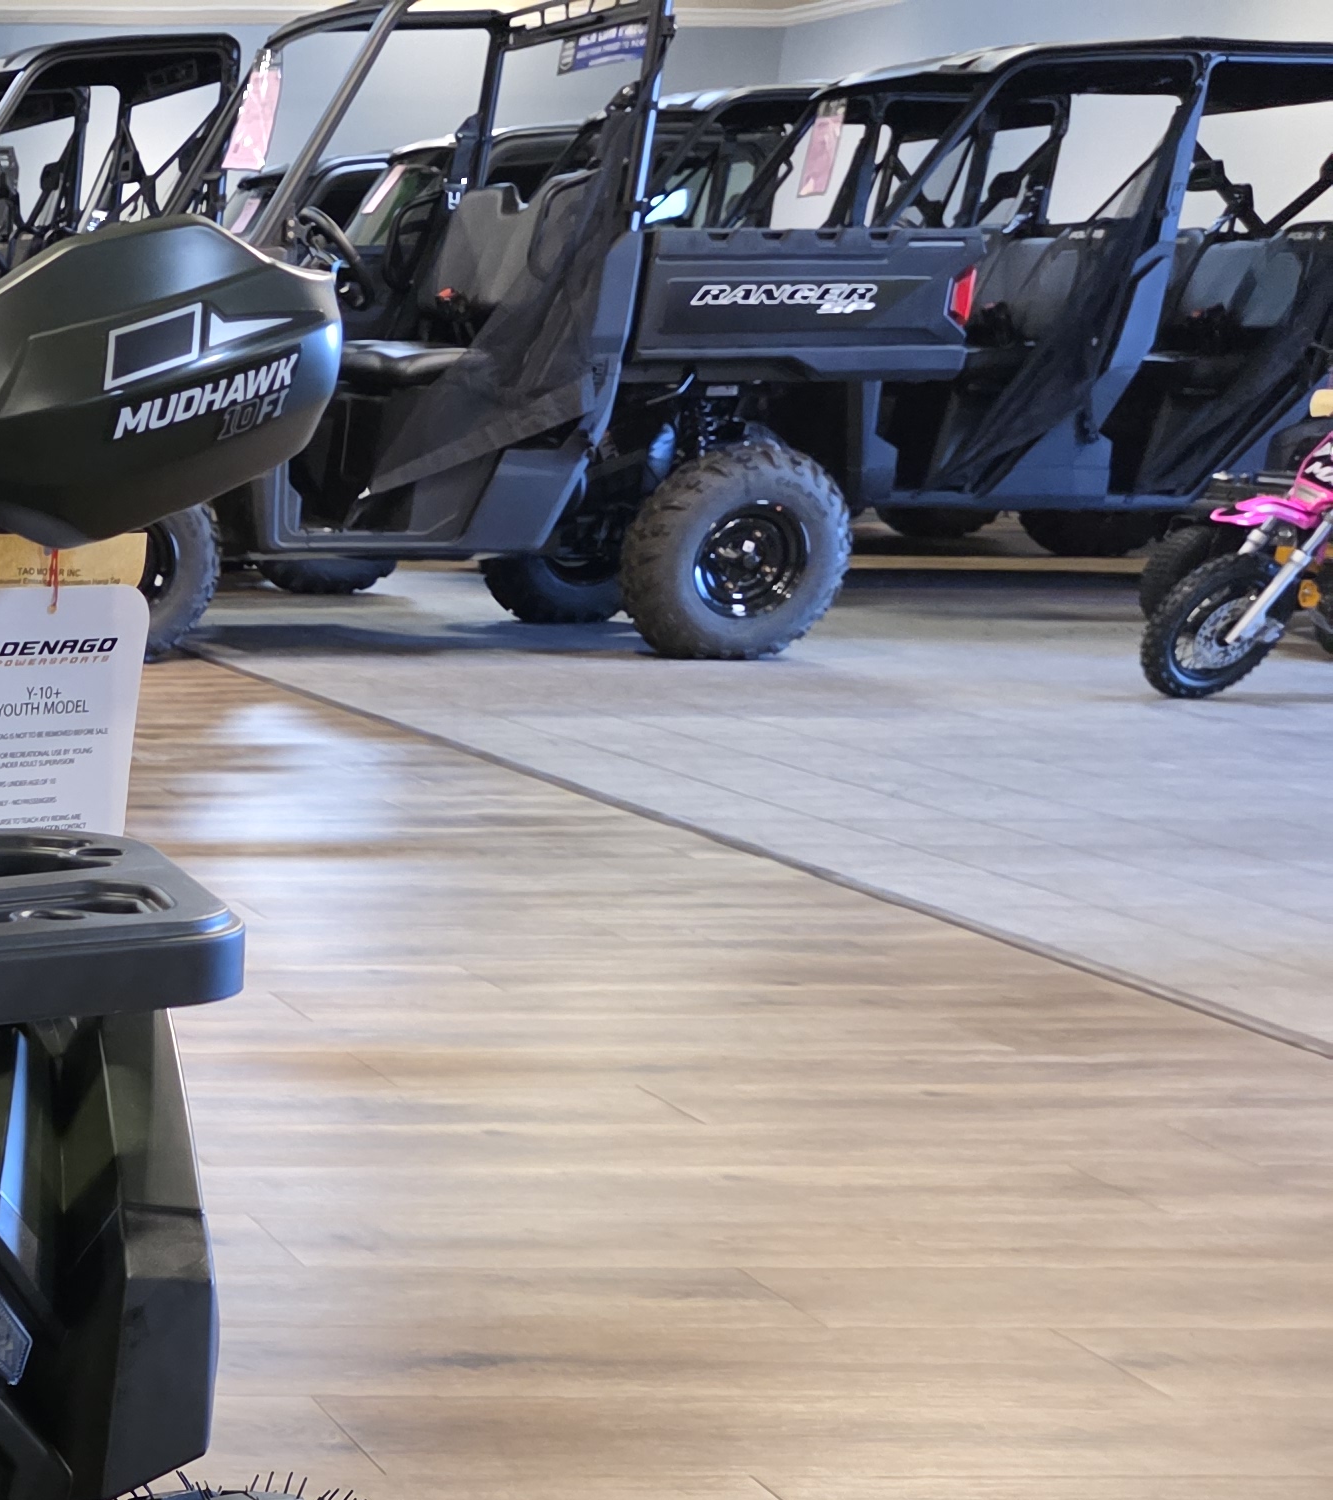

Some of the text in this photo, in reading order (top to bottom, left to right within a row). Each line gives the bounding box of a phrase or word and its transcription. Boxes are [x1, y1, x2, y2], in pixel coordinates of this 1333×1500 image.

[690, 283, 878, 306] RANGER
[113, 353, 299, 440] MUDHAWK
[36, 567, 65, 577] MOR
[26, 686, 62, 700] Y-10+
[43, 699, 89, 715] MODEL
